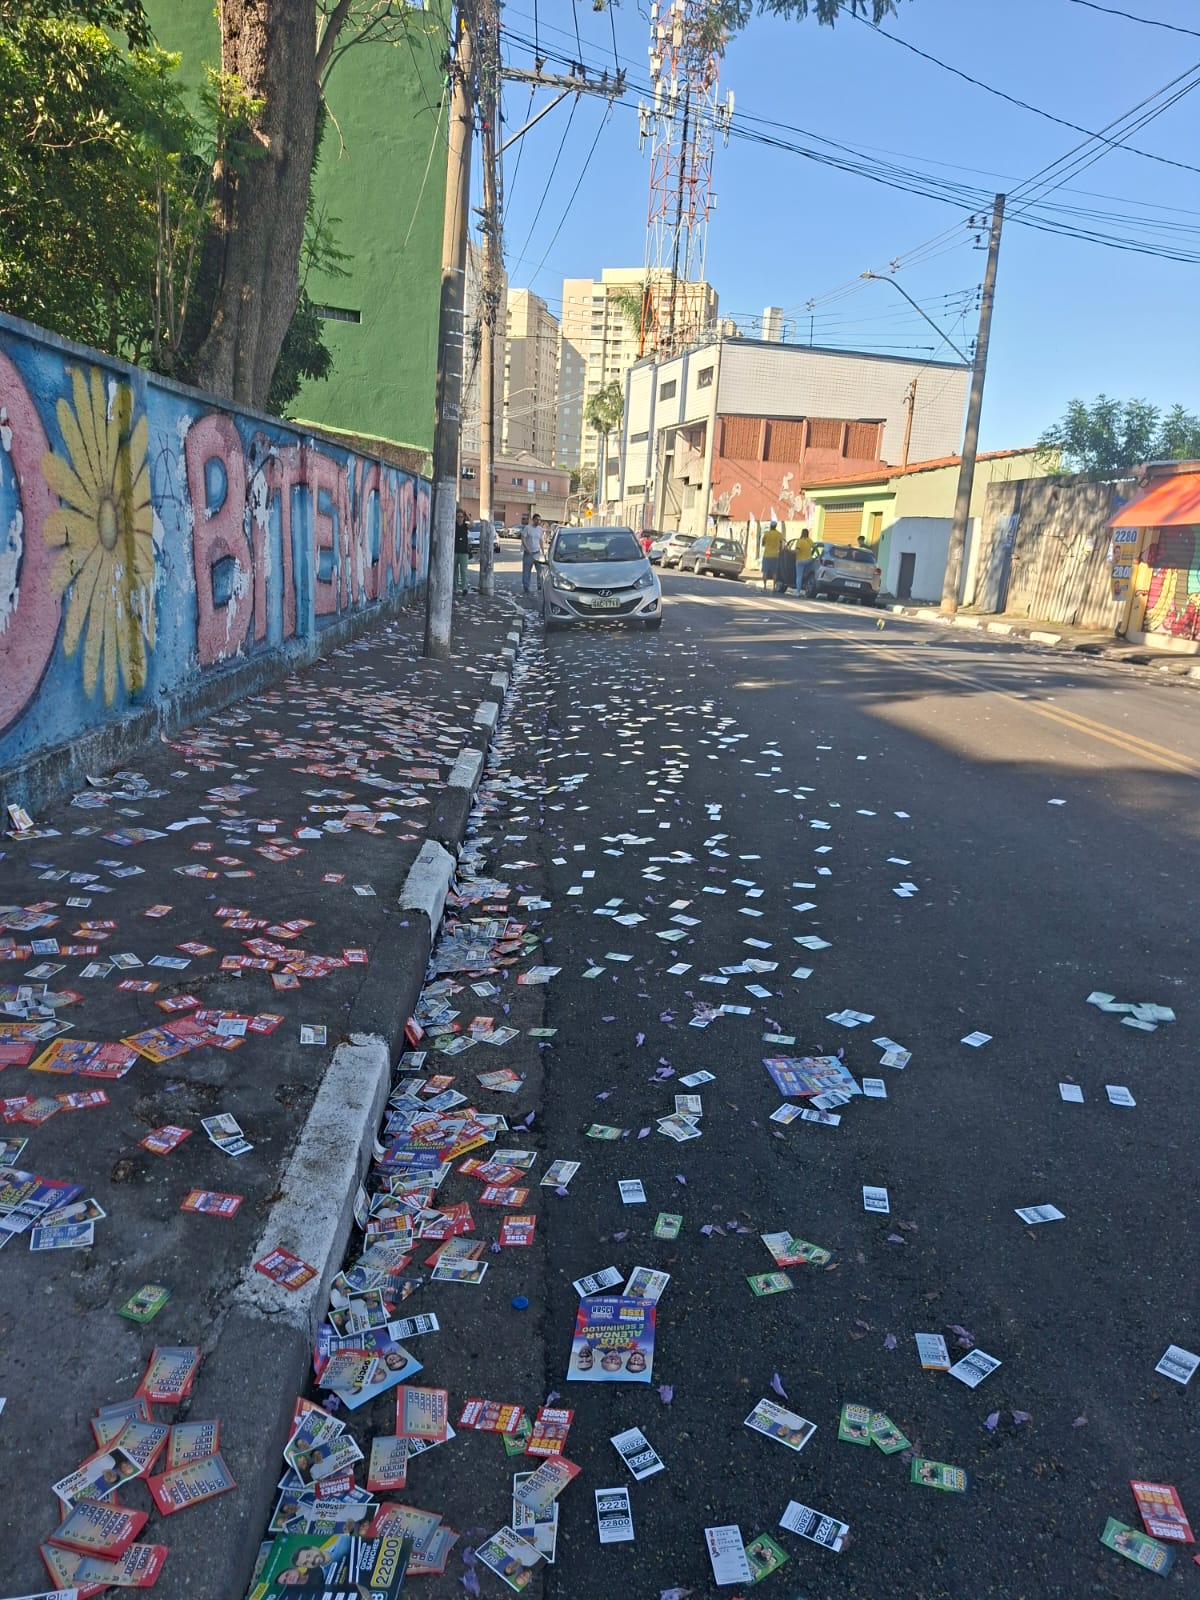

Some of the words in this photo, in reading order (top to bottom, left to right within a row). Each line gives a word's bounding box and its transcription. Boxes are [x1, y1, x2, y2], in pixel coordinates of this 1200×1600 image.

[628, 1450, 655, 1468] 2228
[320, 1482, 349, 1495] 13588
[599, 1501, 626, 1510] 2228
[600, 1518, 629, 1527] 22800
[796, 1508, 812, 1533] 22800
[814, 1517, 831, 1542] 2228
[365, 1538, 379, 1570] SANCHES
[375, 1539, 399, 1583] 22800
